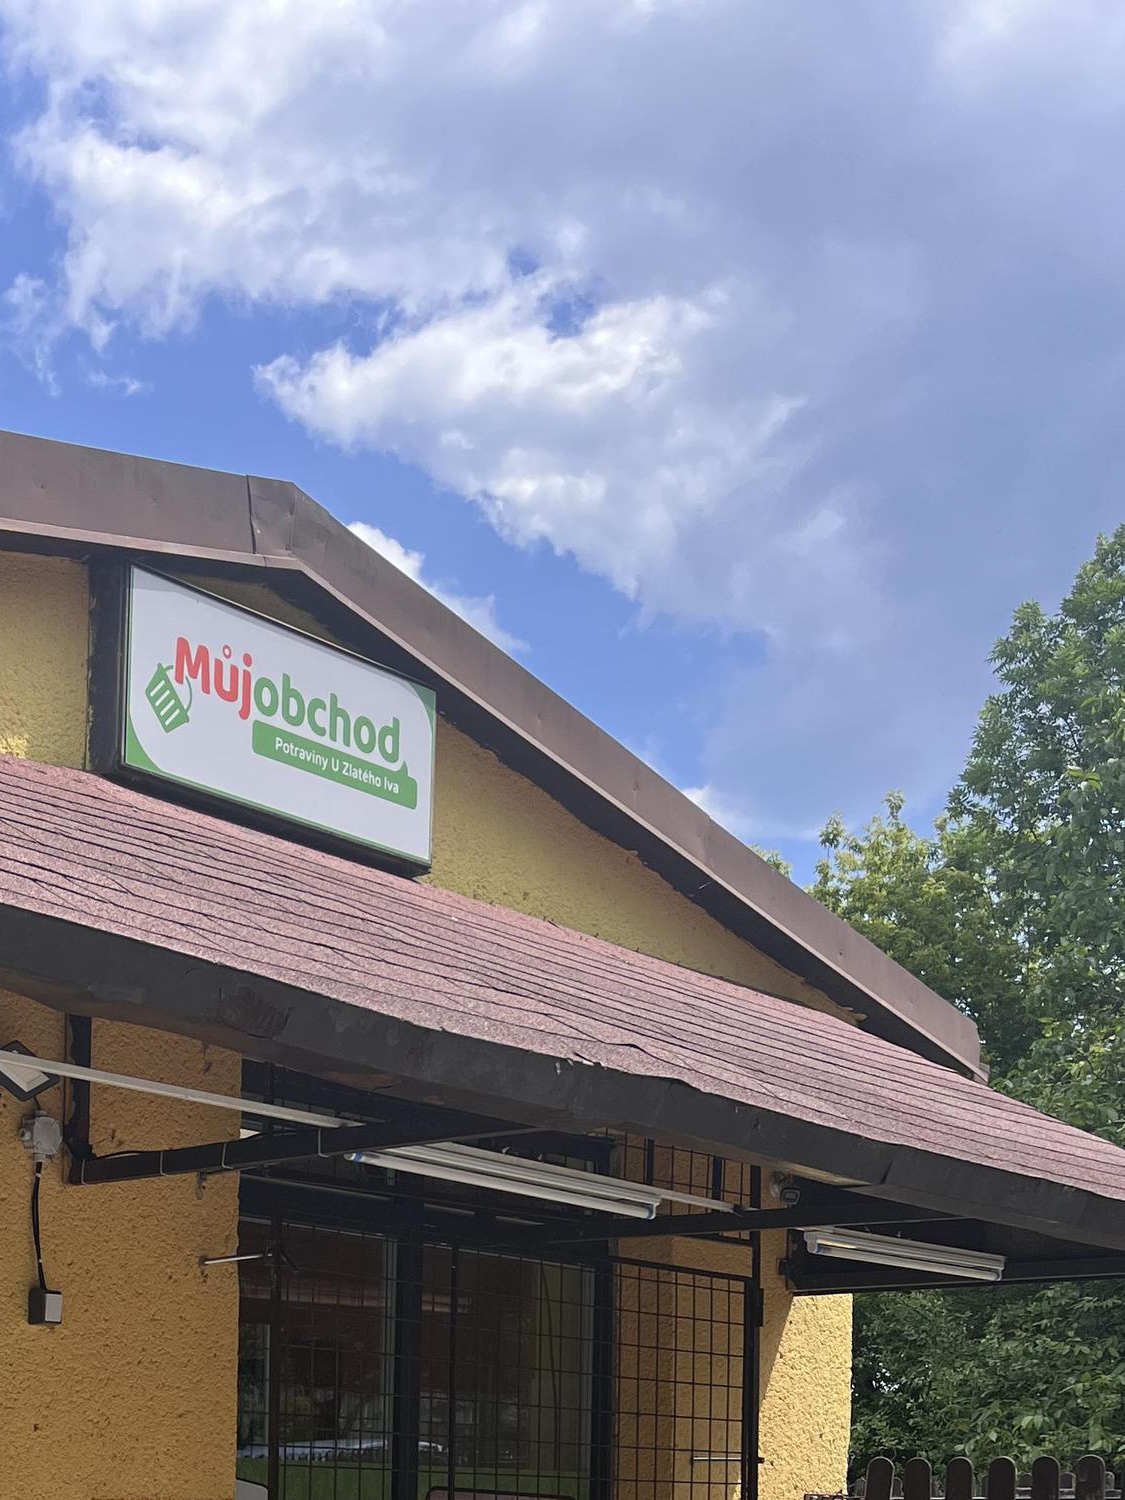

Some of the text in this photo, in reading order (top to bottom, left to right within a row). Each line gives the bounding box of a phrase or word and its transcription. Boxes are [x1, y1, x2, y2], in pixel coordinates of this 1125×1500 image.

[275, 736, 329, 770] Potraviny
[331, 757, 340, 772] U
[342, 761, 382, 788] Zlatého
